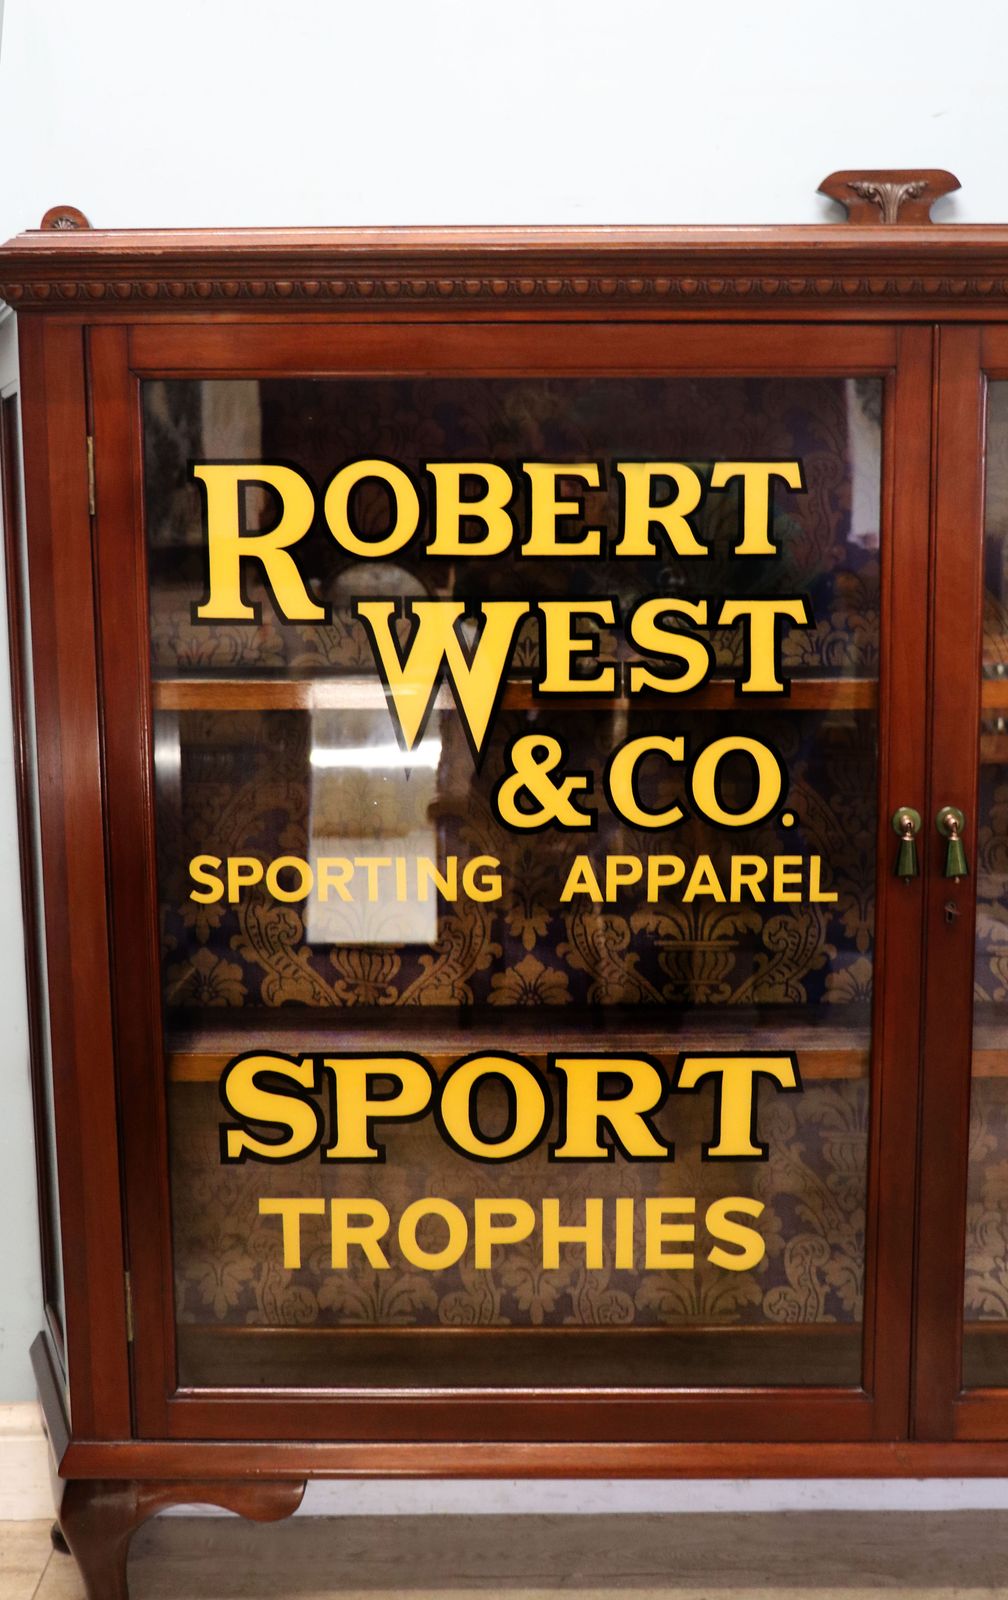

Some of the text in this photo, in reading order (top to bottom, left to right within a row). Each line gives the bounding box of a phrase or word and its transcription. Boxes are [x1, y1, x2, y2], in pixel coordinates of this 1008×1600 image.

[192, 459, 803, 621] ROBERT
[356, 598, 809, 754] WEST
[188, 854, 839, 905] SPORTING APPAREL
[225, 1056, 796, 1159] SPORT
[257, 1196, 767, 1272] TROPHIES
